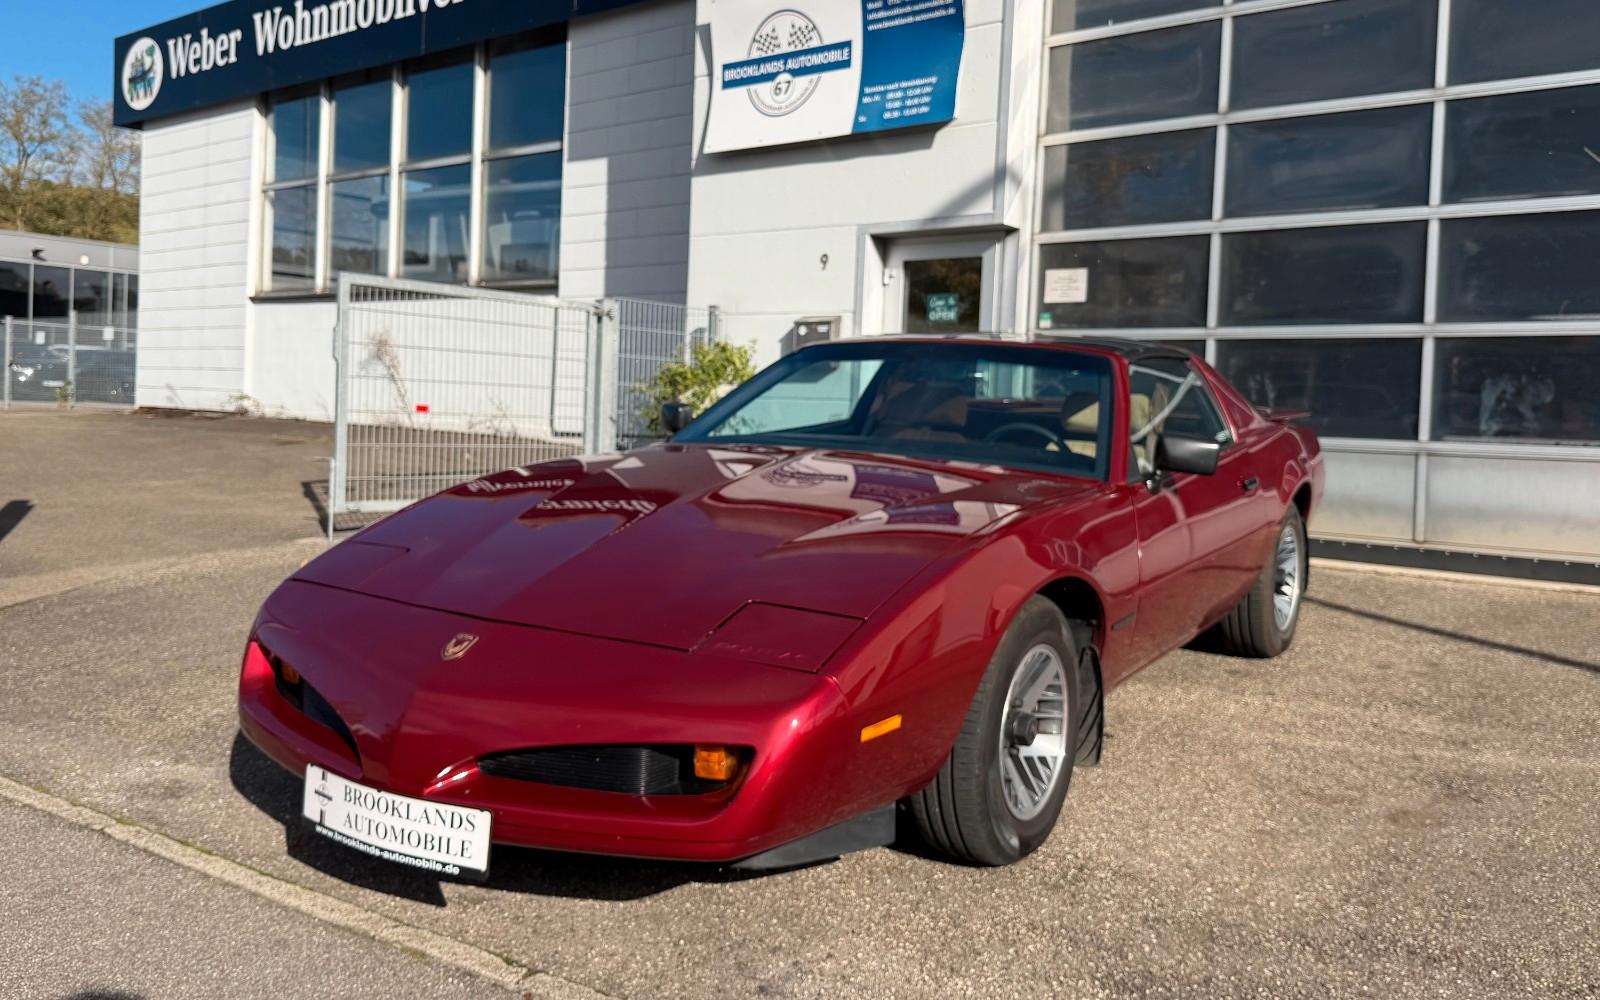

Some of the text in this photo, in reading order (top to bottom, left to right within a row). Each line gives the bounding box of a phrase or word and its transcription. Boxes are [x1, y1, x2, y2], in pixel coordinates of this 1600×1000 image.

[167, 27, 242, 80] Weber
[724, 47, 850, 81] BROOKLANDS AUTOMOBILE
[773, 80, 792, 97] 67
[820, 253, 829, 271] 9
[344, 784, 476, 832] BROOKLANDS
[315, 824, 460, 875] www.brooklands-automobile.de
[343, 812, 473, 859] AUTOMOBILE
